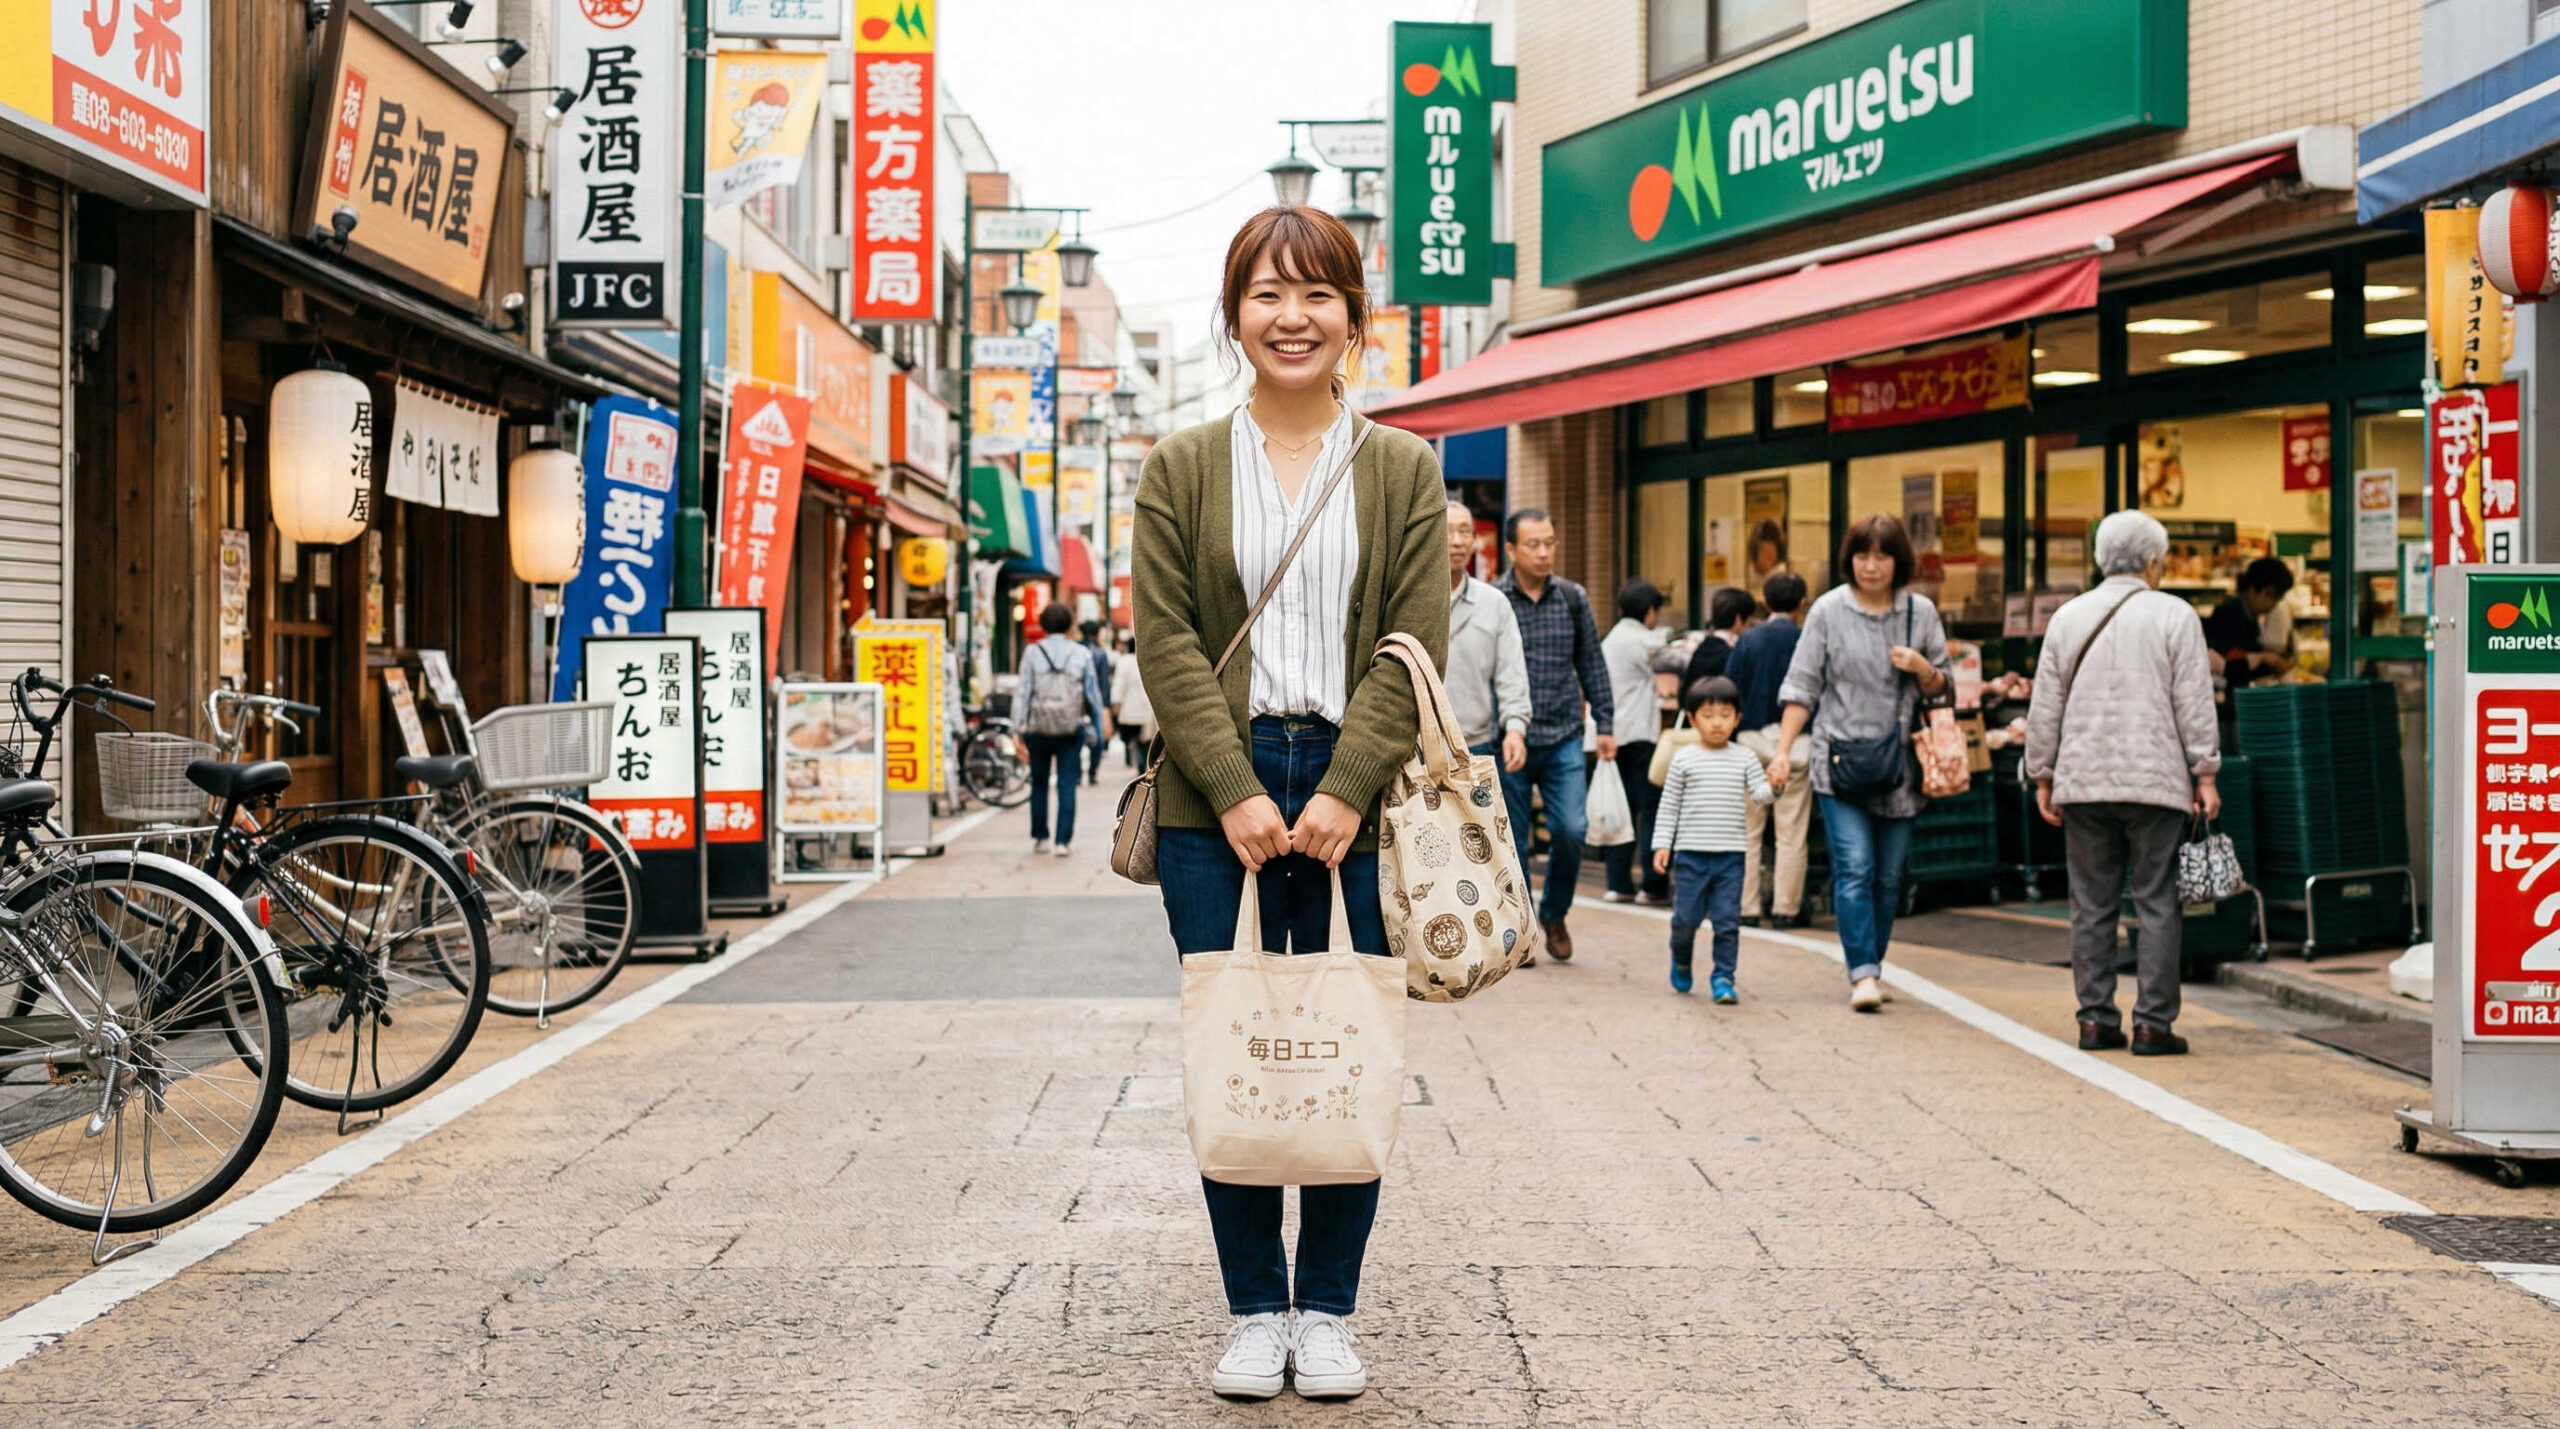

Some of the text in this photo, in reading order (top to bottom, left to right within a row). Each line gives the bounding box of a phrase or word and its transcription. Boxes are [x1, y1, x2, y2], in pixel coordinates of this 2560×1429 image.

[578, 45, 643, 244] 居酒屋
[1728, 34, 1974, 175] maruetsu
[360, 96, 479, 248] 居酒屋
[1802, 137, 1885, 192] マルエツ
[568, 273, 652, 309] JFC
[347, 401, 372, 523] 居酒屋
[657, 652, 681, 728] 居酒屋
[730, 631, 752, 708] 居酒屋
[616, 662, 652, 782] ちんお
[1247, 1035, 1340, 1061] 毎日エコ
